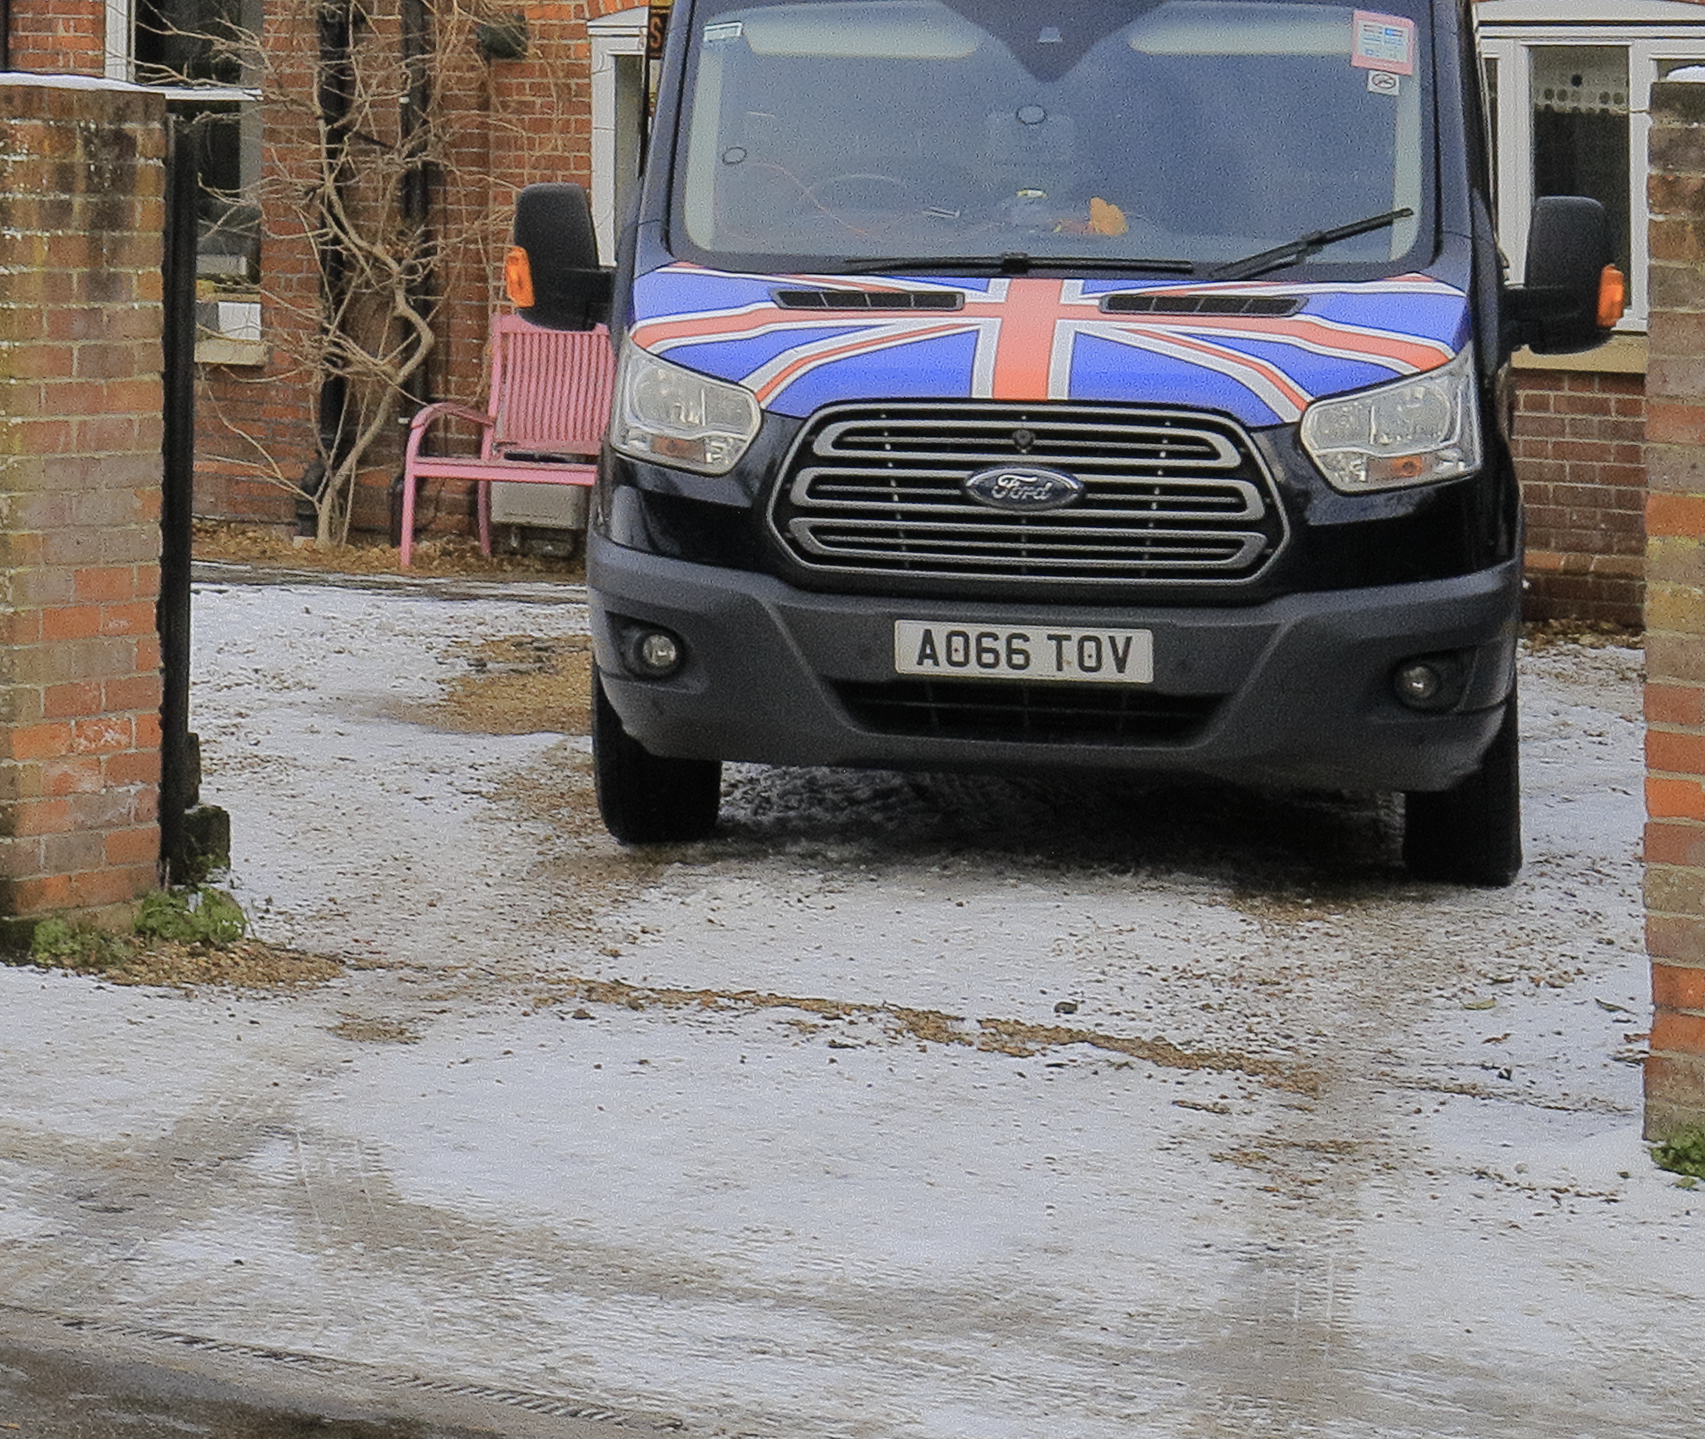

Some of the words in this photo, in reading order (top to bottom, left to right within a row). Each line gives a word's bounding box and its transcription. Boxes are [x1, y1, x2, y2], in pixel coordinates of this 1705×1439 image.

[992, 474, 1050, 502] Ford
[917, 628, 1031, 671] AO66
[1047, 634, 1132, 674] TOV
